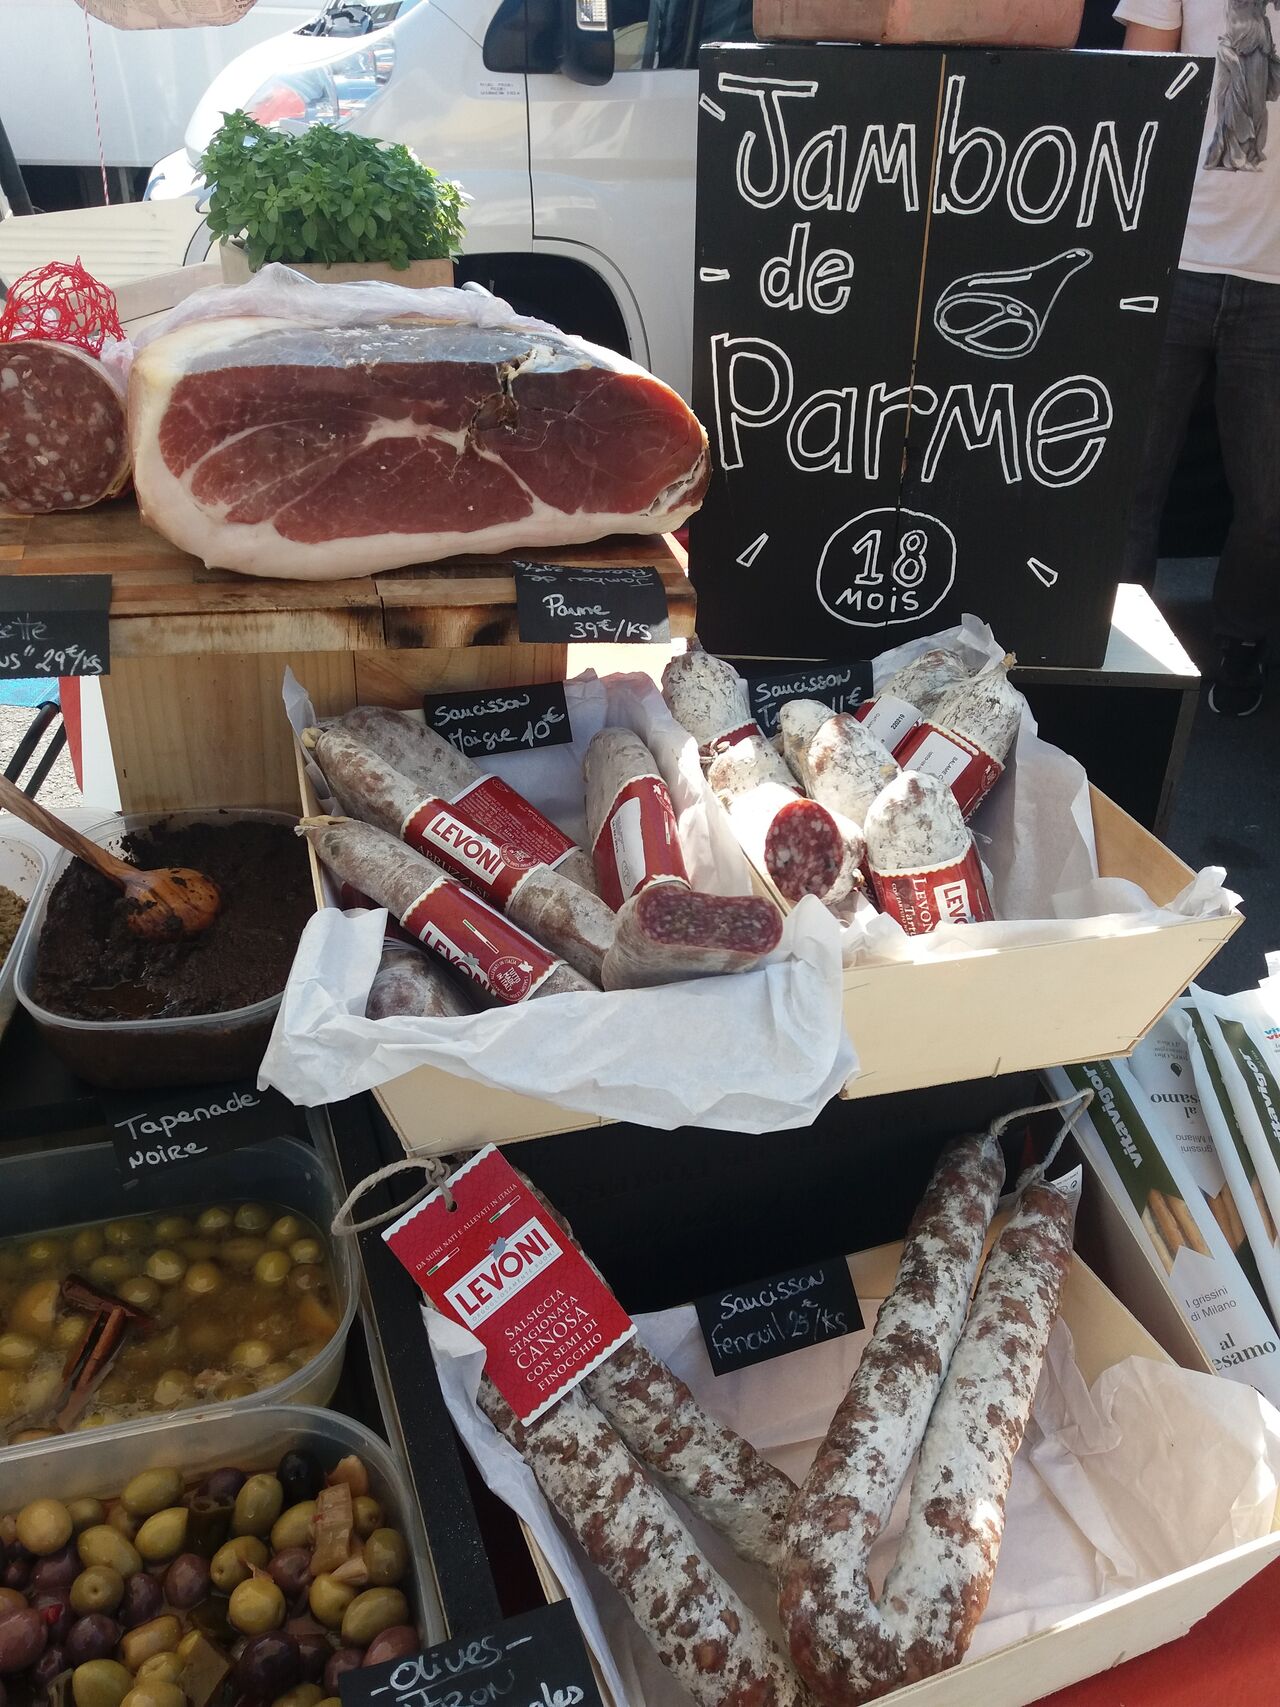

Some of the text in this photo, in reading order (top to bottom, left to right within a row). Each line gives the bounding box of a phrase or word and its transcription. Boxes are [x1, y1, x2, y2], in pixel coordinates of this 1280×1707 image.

[760, 222, 854, 314] de
[851, 529, 928, 587] 18
[433, 693, 531, 727] Saucisson
[754, 669, 851, 702] Saucisson
[431, 817, 500, 875] LEVONI
[510, 967, 521, 983] TUTTO
[114, 1091, 260, 1140] Tapenade
[1082, 1065, 1143, 1169] vitavigor
[1150, 1092, 1200, 1104] samo
[1184, 1106, 1197, 1119] al
[415, 1260, 426, 1271] DA
[425, 1246, 444, 1262] SUINI
[442, 1233, 459, 1248] NATI
[463, 1206, 491, 1232] ALLEVATI
[490, 1200, 499, 1209] IN
[497, 1183, 518, 1202] ITALIA
[454, 1228, 551, 1316] LEVONI
[720, 1269, 825, 1320] Saucisson
[1192, 1285, 1229, 1309] grissini
[504, 1289, 565, 1341] SALSICCIA
[509, 1295, 578, 1356] STAGIONATA
[1190, 1299, 1237, 1322] di Milano
[516, 1306, 590, 1369] CANOSA
[526, 1318, 599, 1382] CON SEMI DI
[537, 1333, 602, 1391] FINOCCHIO
[1211, 1340, 1277, 1371] esamo
[1219, 1332, 1236, 1351] al
